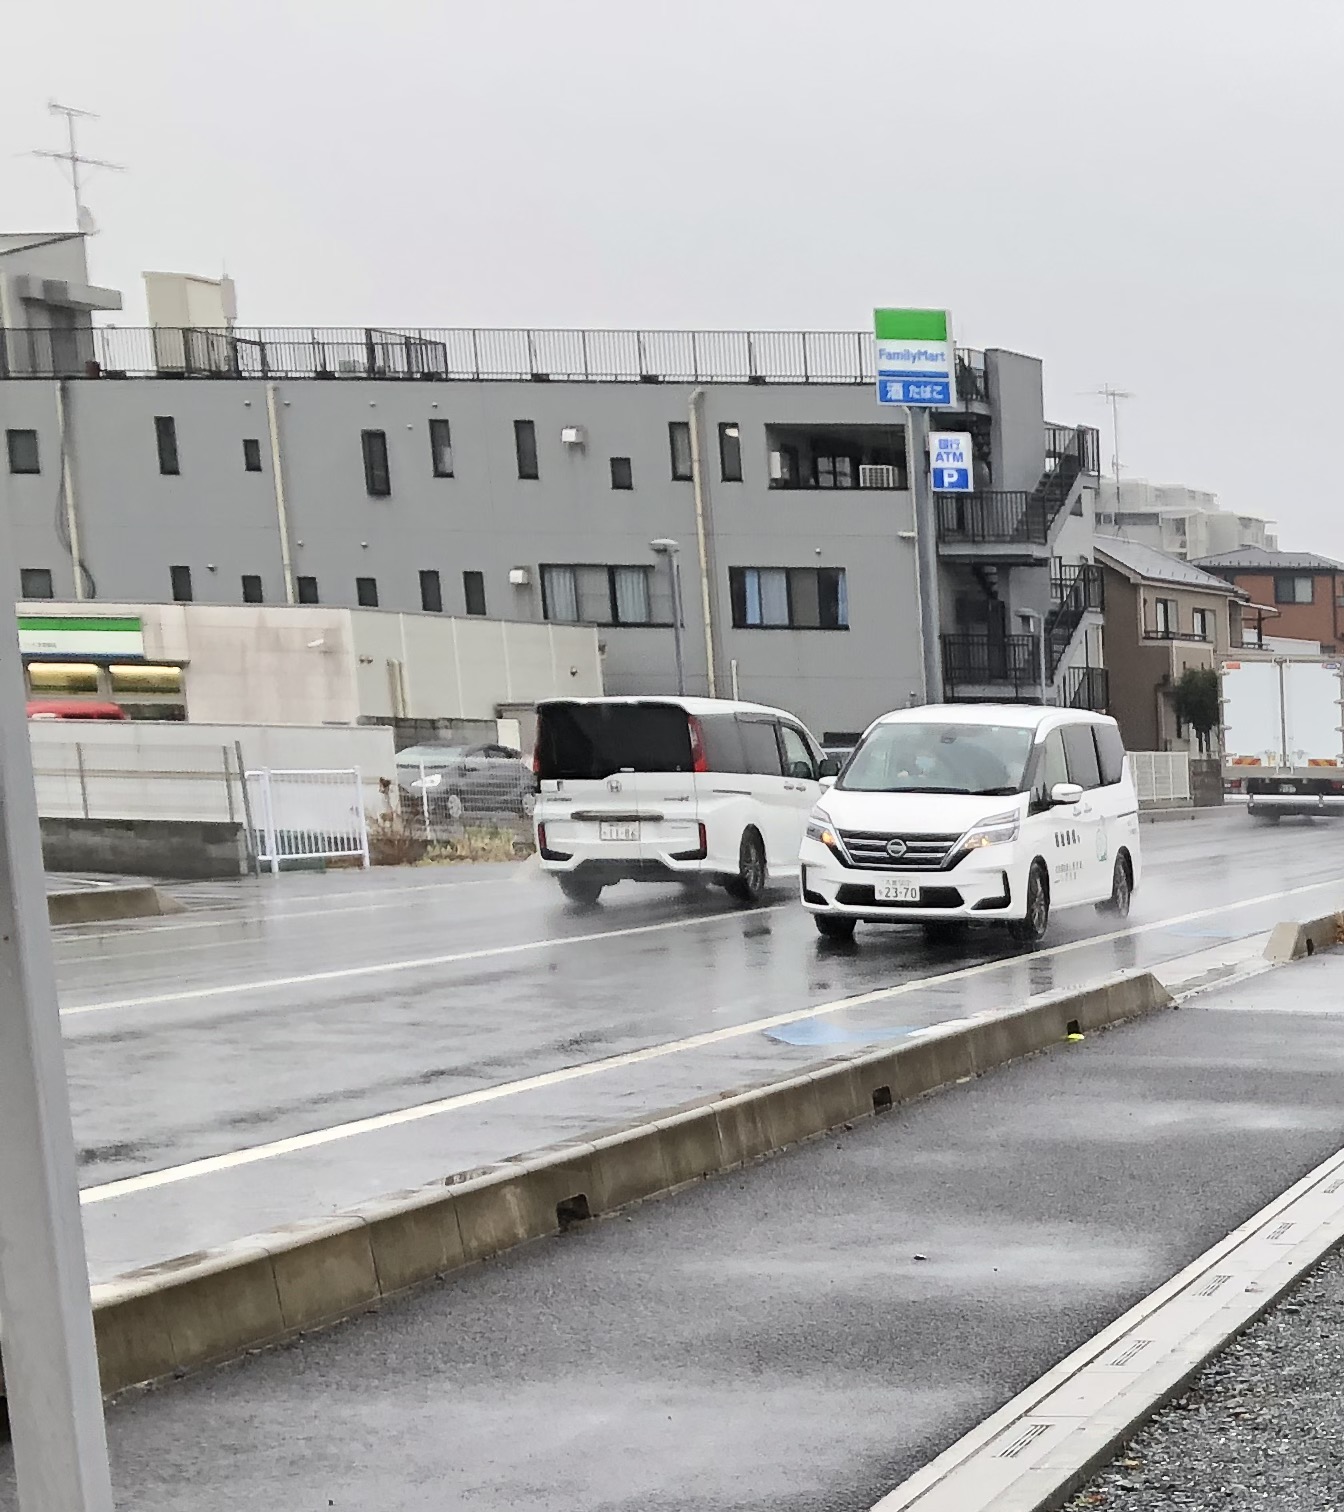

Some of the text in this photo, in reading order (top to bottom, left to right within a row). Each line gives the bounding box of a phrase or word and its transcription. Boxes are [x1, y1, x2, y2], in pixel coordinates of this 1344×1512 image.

[878, 348, 946, 364] FamilyMart
[908, 385, 944, 400] たばこ
[935, 452, 964, 463] ATM
[943, 469, 959, 488] P
[884, 886, 917, 899] 23-70
